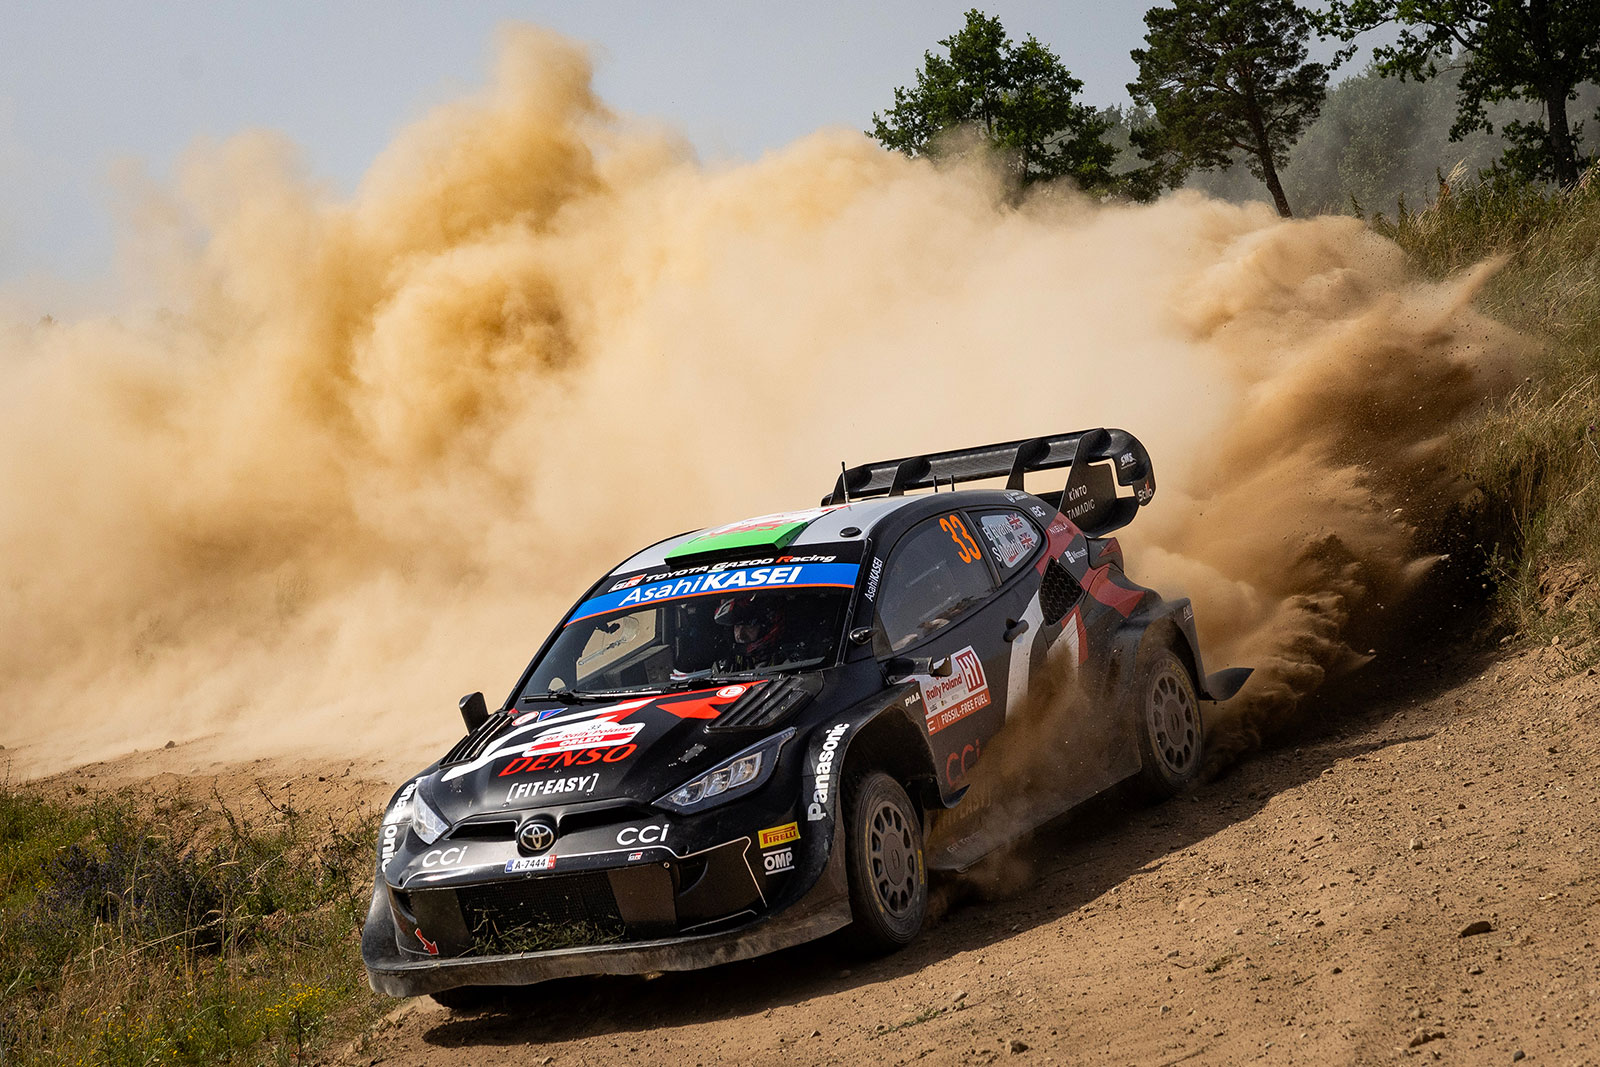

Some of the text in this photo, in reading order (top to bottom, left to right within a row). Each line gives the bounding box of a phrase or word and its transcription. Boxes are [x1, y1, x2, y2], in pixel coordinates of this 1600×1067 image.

[1067, 499, 1096, 520] TAMADIC
[939, 514, 982, 564] 33
[646, 566, 711, 583] TOYOTA
[706, 556, 775, 574] GAZOO
[775, 554, 837, 565] Racing
[864, 556, 883, 602] AsahiKASEI
[618, 566, 804, 607] AsahiKASEI
[958, 653, 982, 690] HY
[904, 692, 921, 707] PIAA
[926, 685, 942, 701] Rally
[941, 673, 963, 693] Poland
[941, 699, 975, 725] FOSSIL-FREE
[974, 693, 988, 708] FUEL
[559, 735, 604, 747] ORLEN
[497, 743, 638, 777] DENSO
[807, 723, 850, 822] Panasonic
[616, 823, 670, 846] CCi
[763, 825, 797, 845] PIRELLI
[422, 846, 469, 868] CCi
[514, 858, 546, 870] A-7444
[763, 851, 793, 871] OMP
